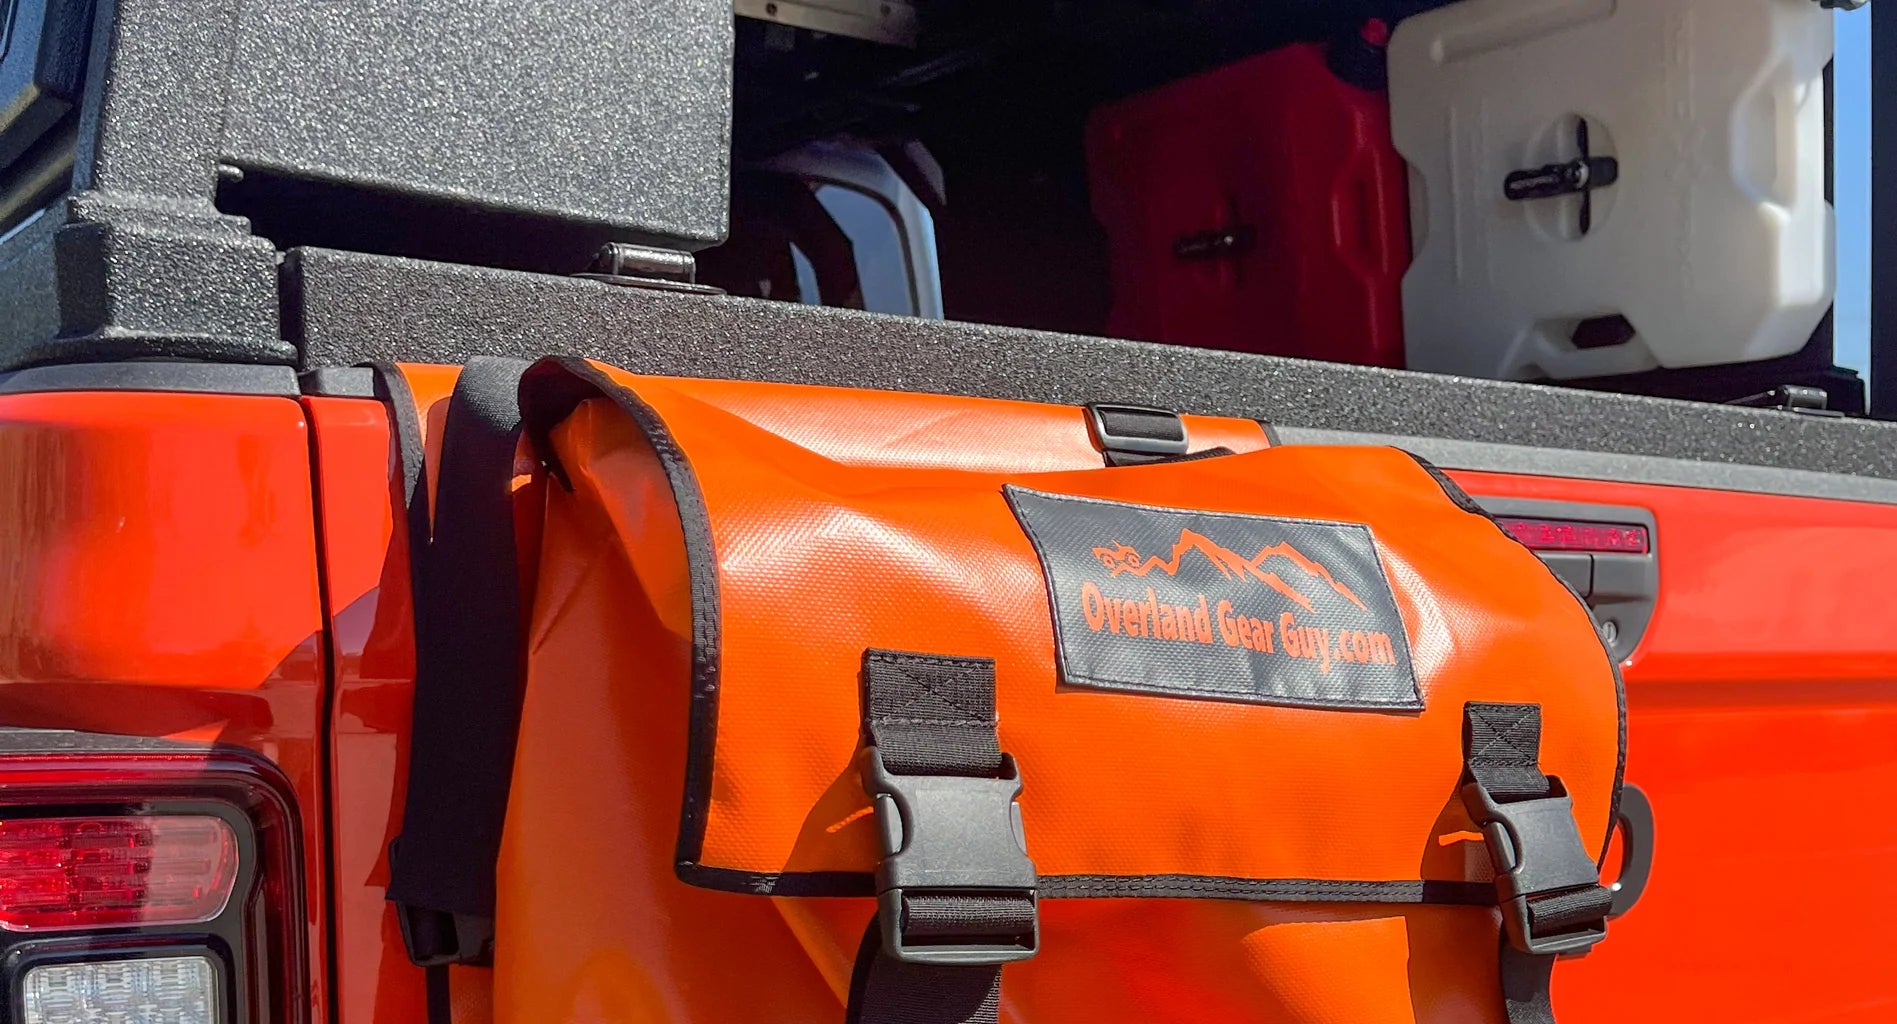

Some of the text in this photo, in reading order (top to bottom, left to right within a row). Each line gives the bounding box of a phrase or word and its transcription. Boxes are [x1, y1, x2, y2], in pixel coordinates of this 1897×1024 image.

[1081, 581, 1396, 676] Overland Gear Guy.com
